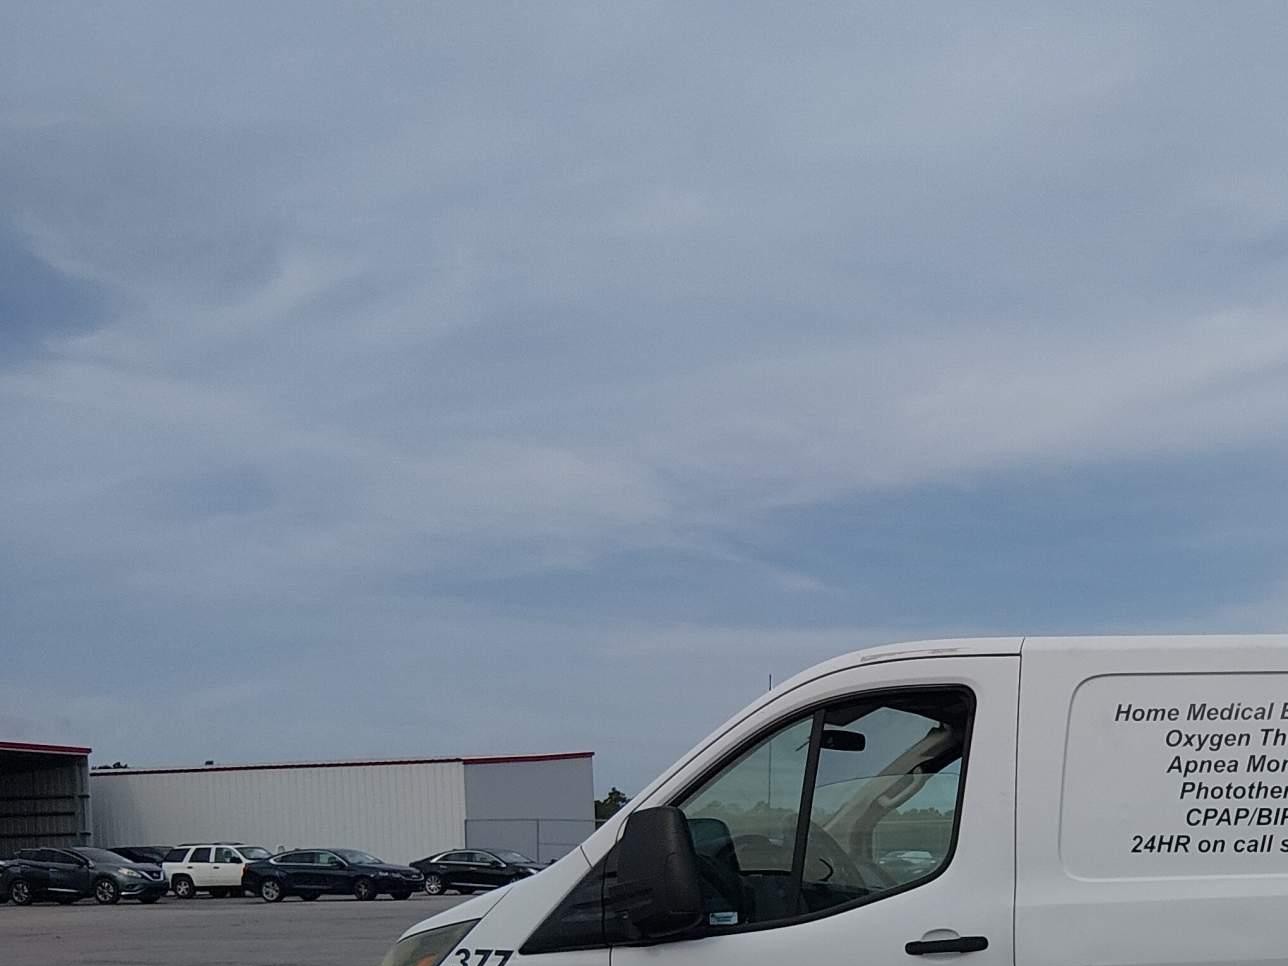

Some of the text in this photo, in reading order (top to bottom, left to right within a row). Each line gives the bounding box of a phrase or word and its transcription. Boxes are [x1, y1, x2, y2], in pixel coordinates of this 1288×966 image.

[1114, 703, 1180, 722] Home
[1186, 702, 1275, 722] Medical
[1165, 729, 1251, 751] Oxygen
[1166, 755, 1239, 778] Apnea
[1131, 834, 1190, 853] 24HR
[1198, 839, 1226, 853] on
[1233, 834, 1274, 853] call
